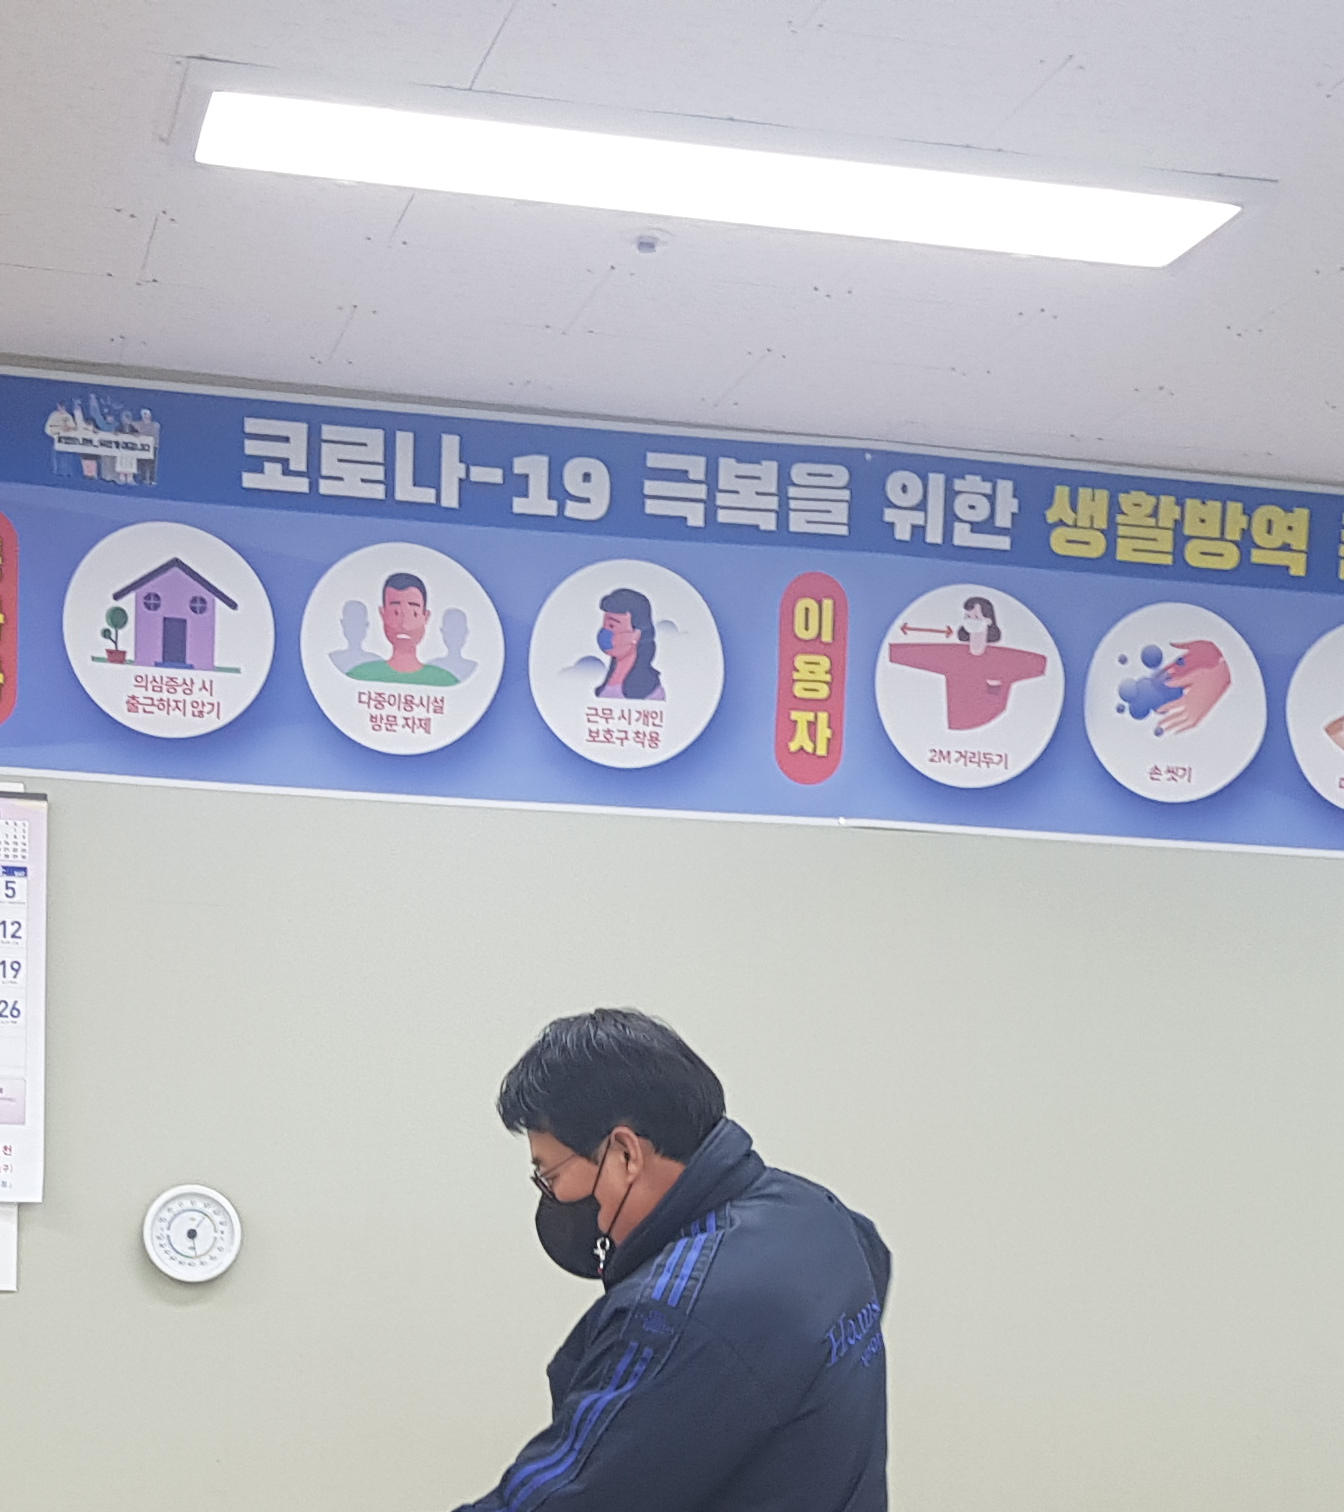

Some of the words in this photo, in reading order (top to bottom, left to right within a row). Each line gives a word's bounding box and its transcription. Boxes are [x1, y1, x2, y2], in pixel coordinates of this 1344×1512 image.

[241, 416, 611, 521] 코로나-19
[642, 451, 852, 536] 극복을
[883, 467, 1019, 551] 위한
[1044, 482, 1311, 576] 생활방역
[133, 673, 196, 695] 의심증상
[198, 678, 215, 697] 시
[789, 596, 834, 758] 이용자
[125, 694, 187, 717] 출근하지
[191, 700, 222, 720] 않기
[356, 690, 445, 714] 다중이용시설
[368, 713, 398, 733] 방문
[401, 715, 432, 735] 자제
[584, 706, 616, 724] 근무
[617, 707, 633, 725] 시
[635, 708, 664, 728] 개인
[584, 728, 630, 748] 보호구
[633, 730, 662, 749] 착용
[927, 748, 951, 764] 2M
[954, 749, 1009, 770] 거리두기
[1147, 764, 1163, 782] 손
[1165, 766, 1193, 784] 씻기
[4, 881, 16, 898] 5
[0, 920, 22, 939] 12
